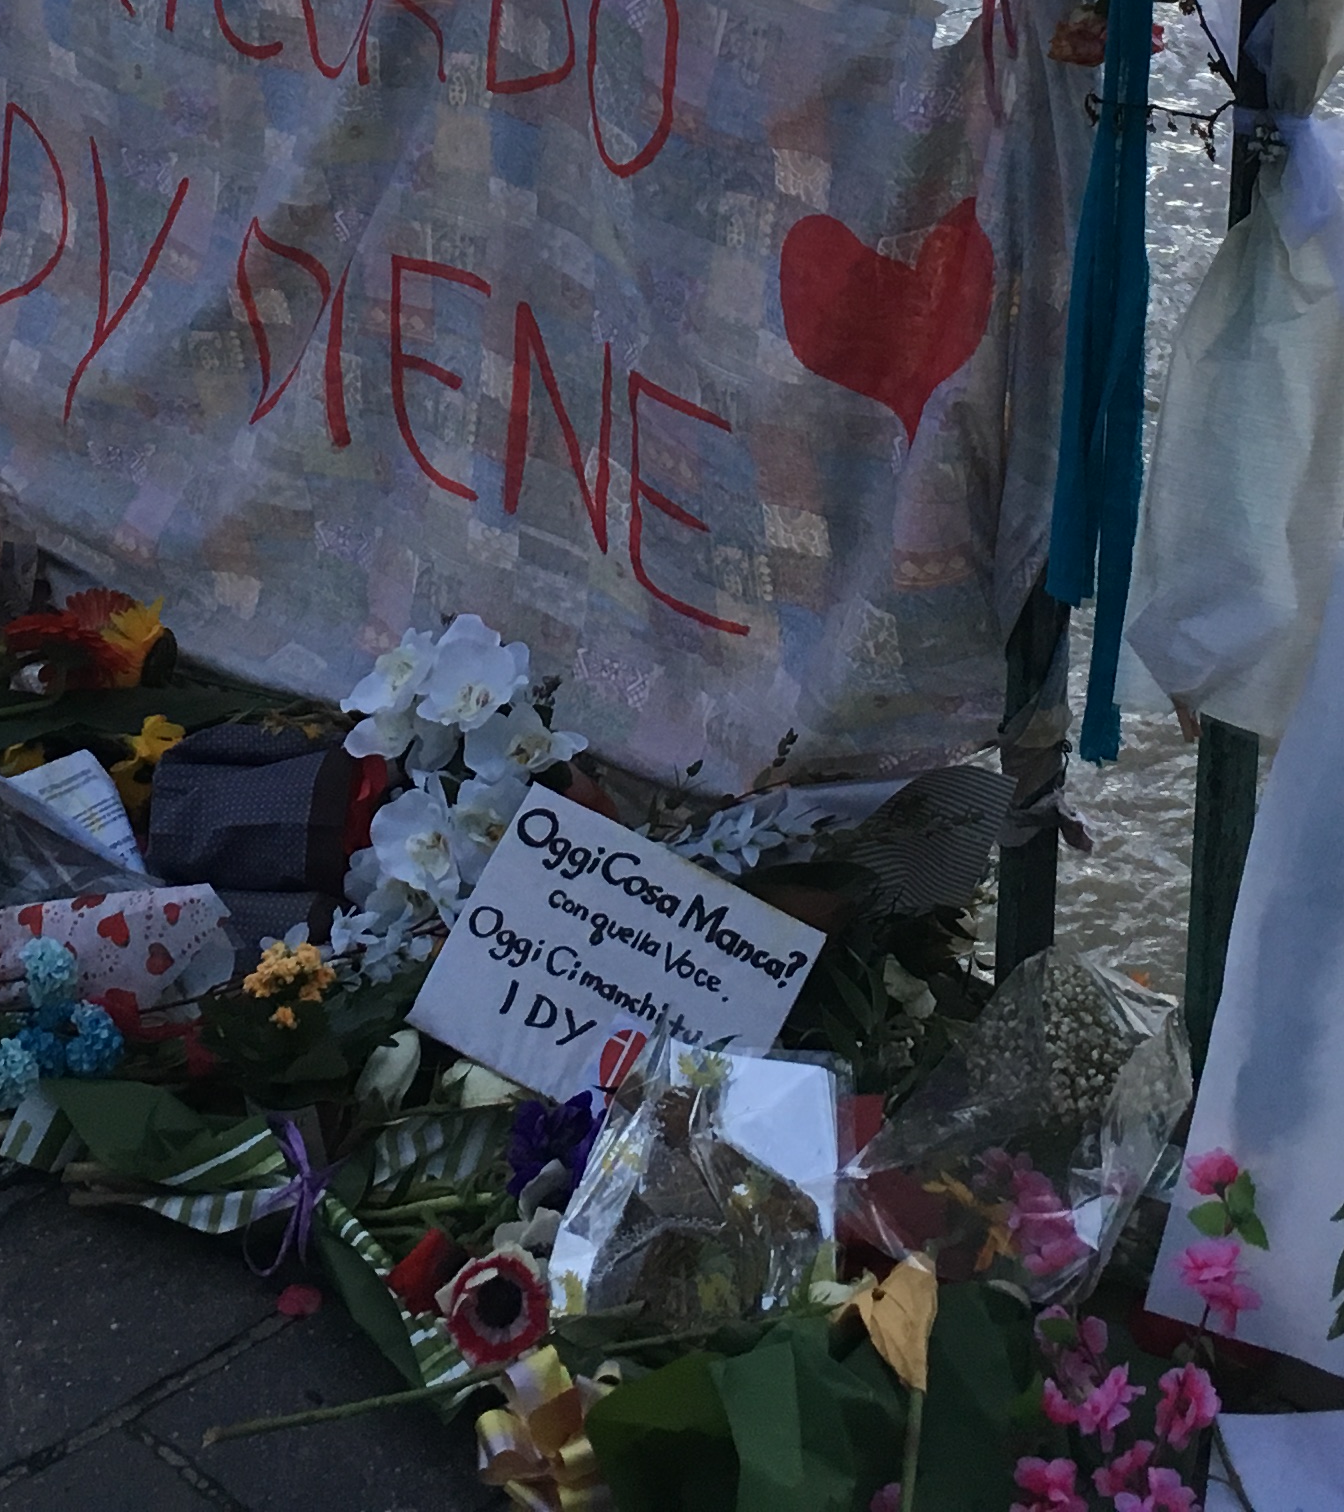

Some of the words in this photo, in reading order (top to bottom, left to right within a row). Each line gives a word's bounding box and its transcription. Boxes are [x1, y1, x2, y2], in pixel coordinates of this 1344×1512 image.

[235, 215, 752, 637] DIENE
[516, 807, 605, 880] Oggi
[600, 851, 682, 919] Cosa
[677, 893, 809, 989] Manca?
[547, 889, 590, 921] con
[589, 912, 662, 947] quella
[468, 905, 546, 968] Oggi
[498, 979, 598, 1046] IDY
